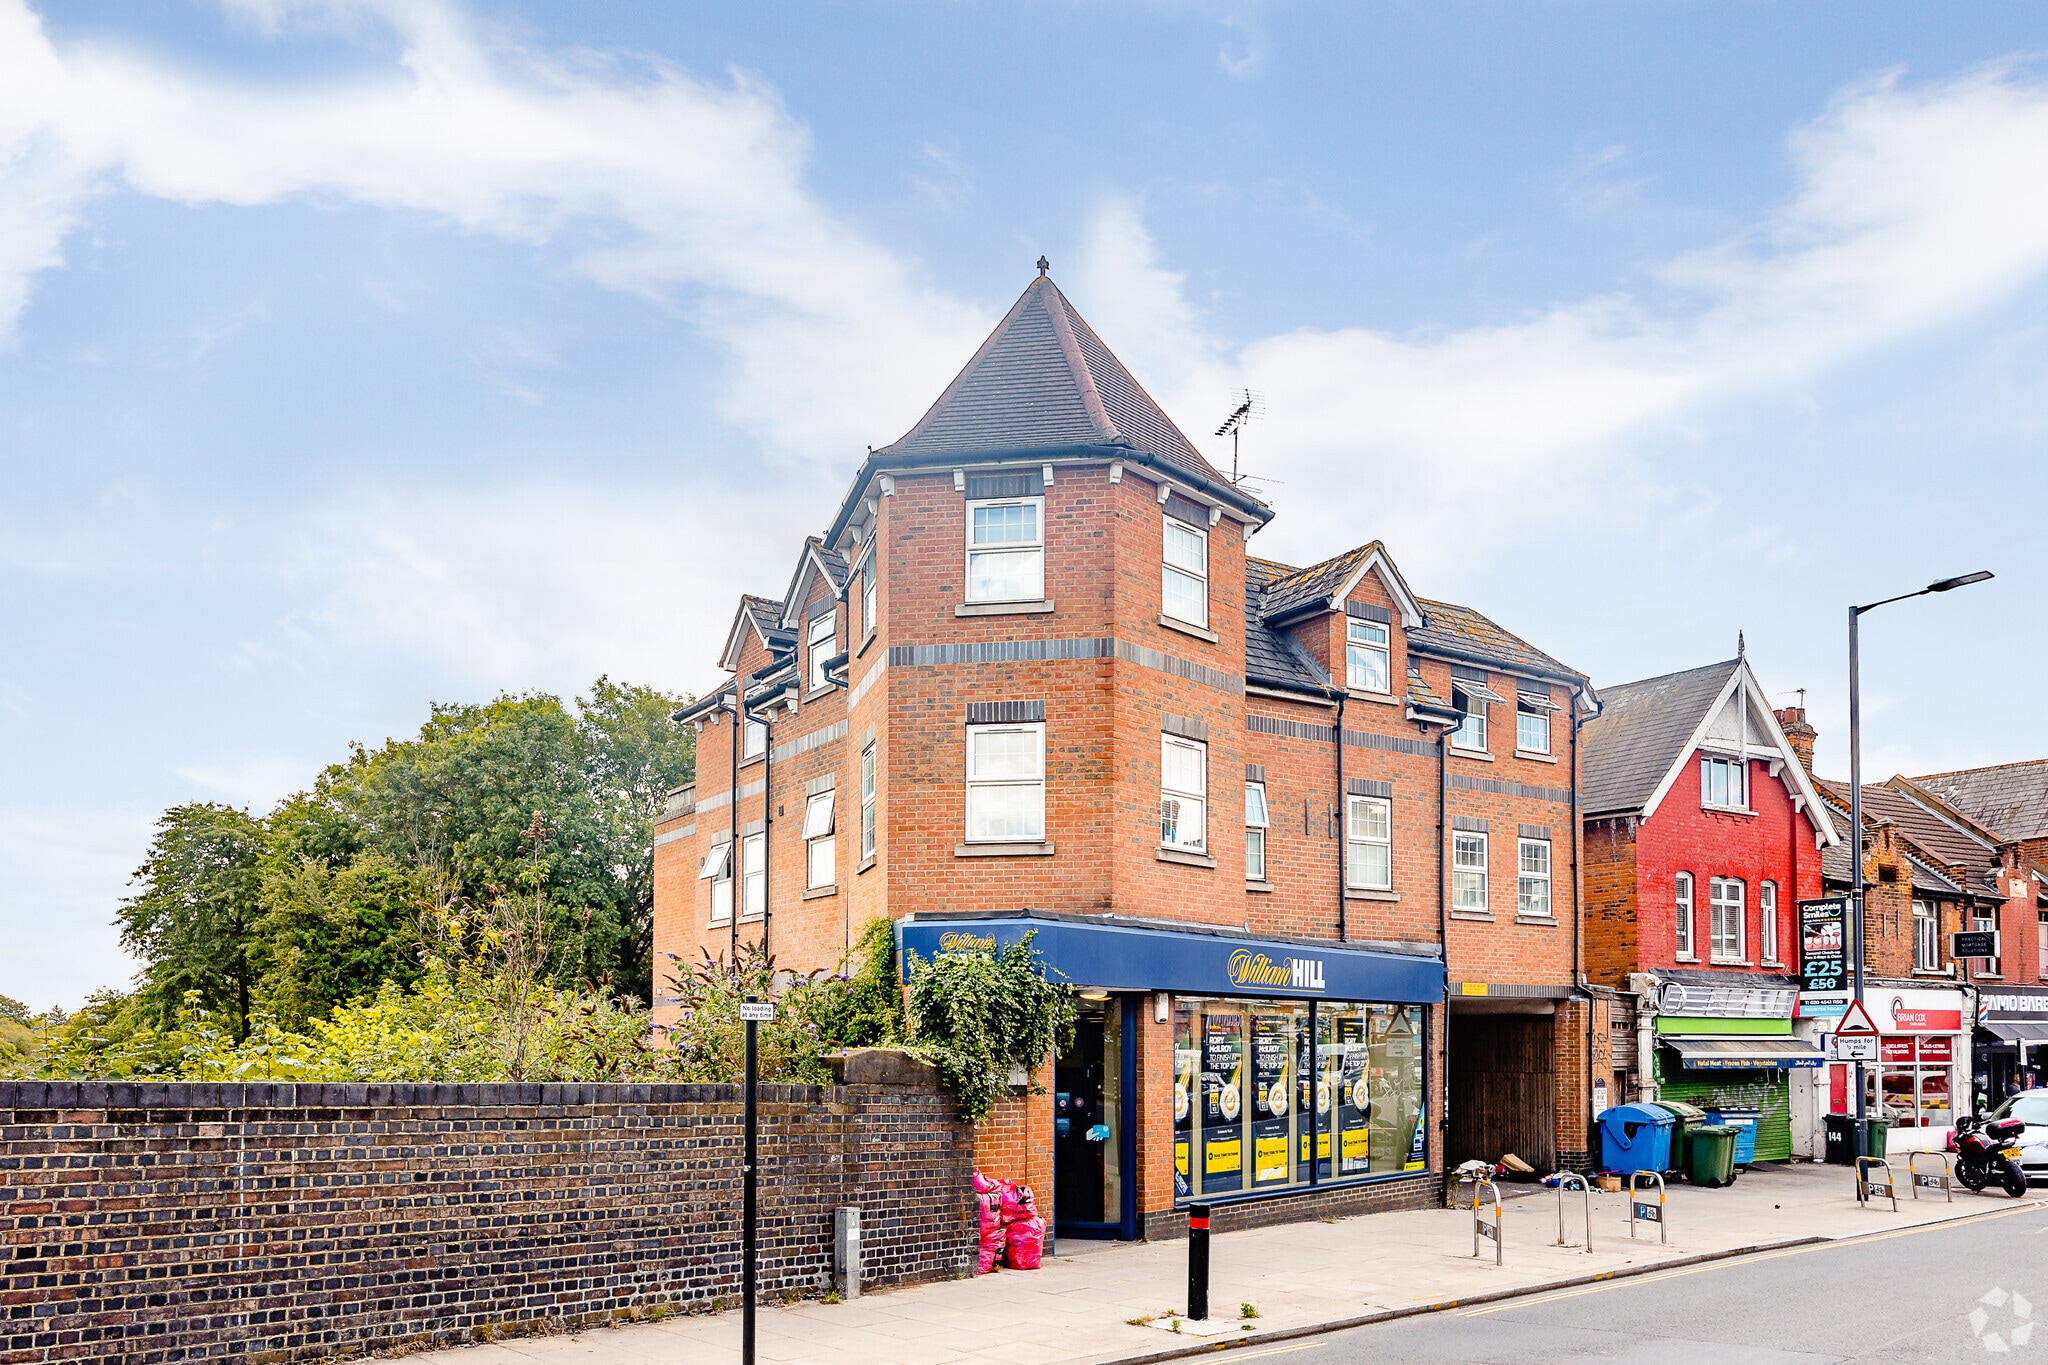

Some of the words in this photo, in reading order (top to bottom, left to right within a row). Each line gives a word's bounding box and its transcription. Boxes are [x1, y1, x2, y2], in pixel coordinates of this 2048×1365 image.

[1803, 903, 1841, 912] Complete
[1227, 948, 1293, 987] William
[1292, 958, 1326, 988] HILL
[1804, 960, 1842, 977] £25
[1808, 978, 1836, 989] £50
[1898, 1013, 1914, 1022] BRIAN
[1915, 1014, 1926, 1022] COX
[1829, 1132, 1842, 1142] 144
[1922, 1176, 1928, 1185] P
[1868, 1184, 1874, 1194] P
[1640, 1206, 1646, 1216] P
